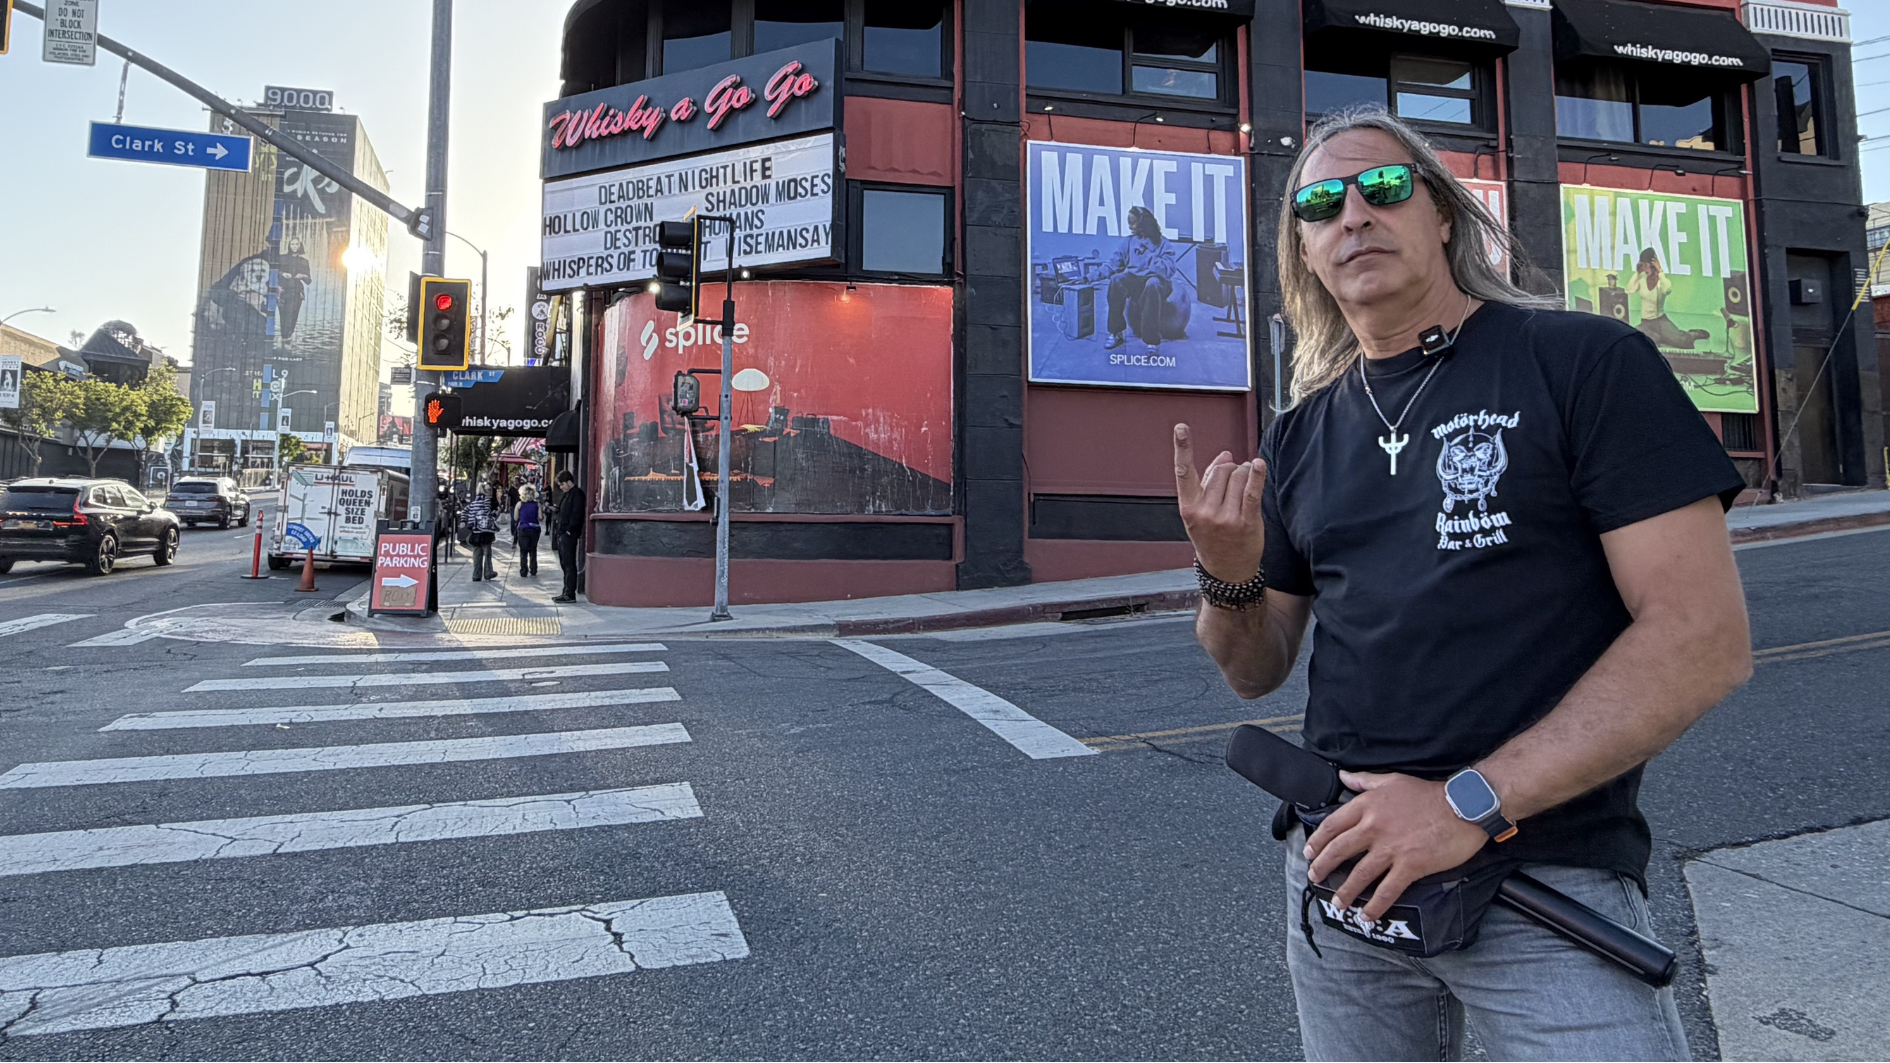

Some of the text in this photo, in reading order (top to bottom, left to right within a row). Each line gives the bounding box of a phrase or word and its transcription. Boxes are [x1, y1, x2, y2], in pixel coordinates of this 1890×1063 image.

[58, 7, 85, 18] DO NOT
[60, 18, 82, 29] BLOCK
[1355, 13, 1496, 39] whiskyagogo.com
[47, 28, 93, 41] INTERSECTION
[1613, 43, 1744, 66] whiskyagogo.com
[267, 89, 331, 109] 9000
[549, 60, 818, 149] Whisky a Go Go
[111, 134, 195, 156] Clark St
[296, 134, 347, 144] SEASON
[599, 156, 772, 206] DEADBEAT NIGHTLIFE
[1041, 150, 1234, 244] MAKE IT
[543, 172, 832, 236] HOLLOW CROWN SHADOW MOSES
[604, 223, 660, 251] DESTRO
[1574, 194, 1691, 276] MAKE
[1697, 204, 1733, 279] IT
[542, 253, 614, 281] WHISPERS
[617, 250, 636, 271] OF
[1109, 354, 1176, 367] SPLICE.COM
[452, 371, 484, 381] CLARK
[462, 416, 553, 430] hiskyagogo.c
[314, 473, 355, 483] U-HAUL
[341, 489, 374, 499] HOLDS
[339, 498, 374, 507] QUEEN-
[344, 507, 366, 516] SIZE
[344, 515, 365, 525] BED
[1437, 529, 1508, 550] Bar & Grill
[381, 543, 428, 556] PUBLIC
[377, 556, 428, 568] PARKING
